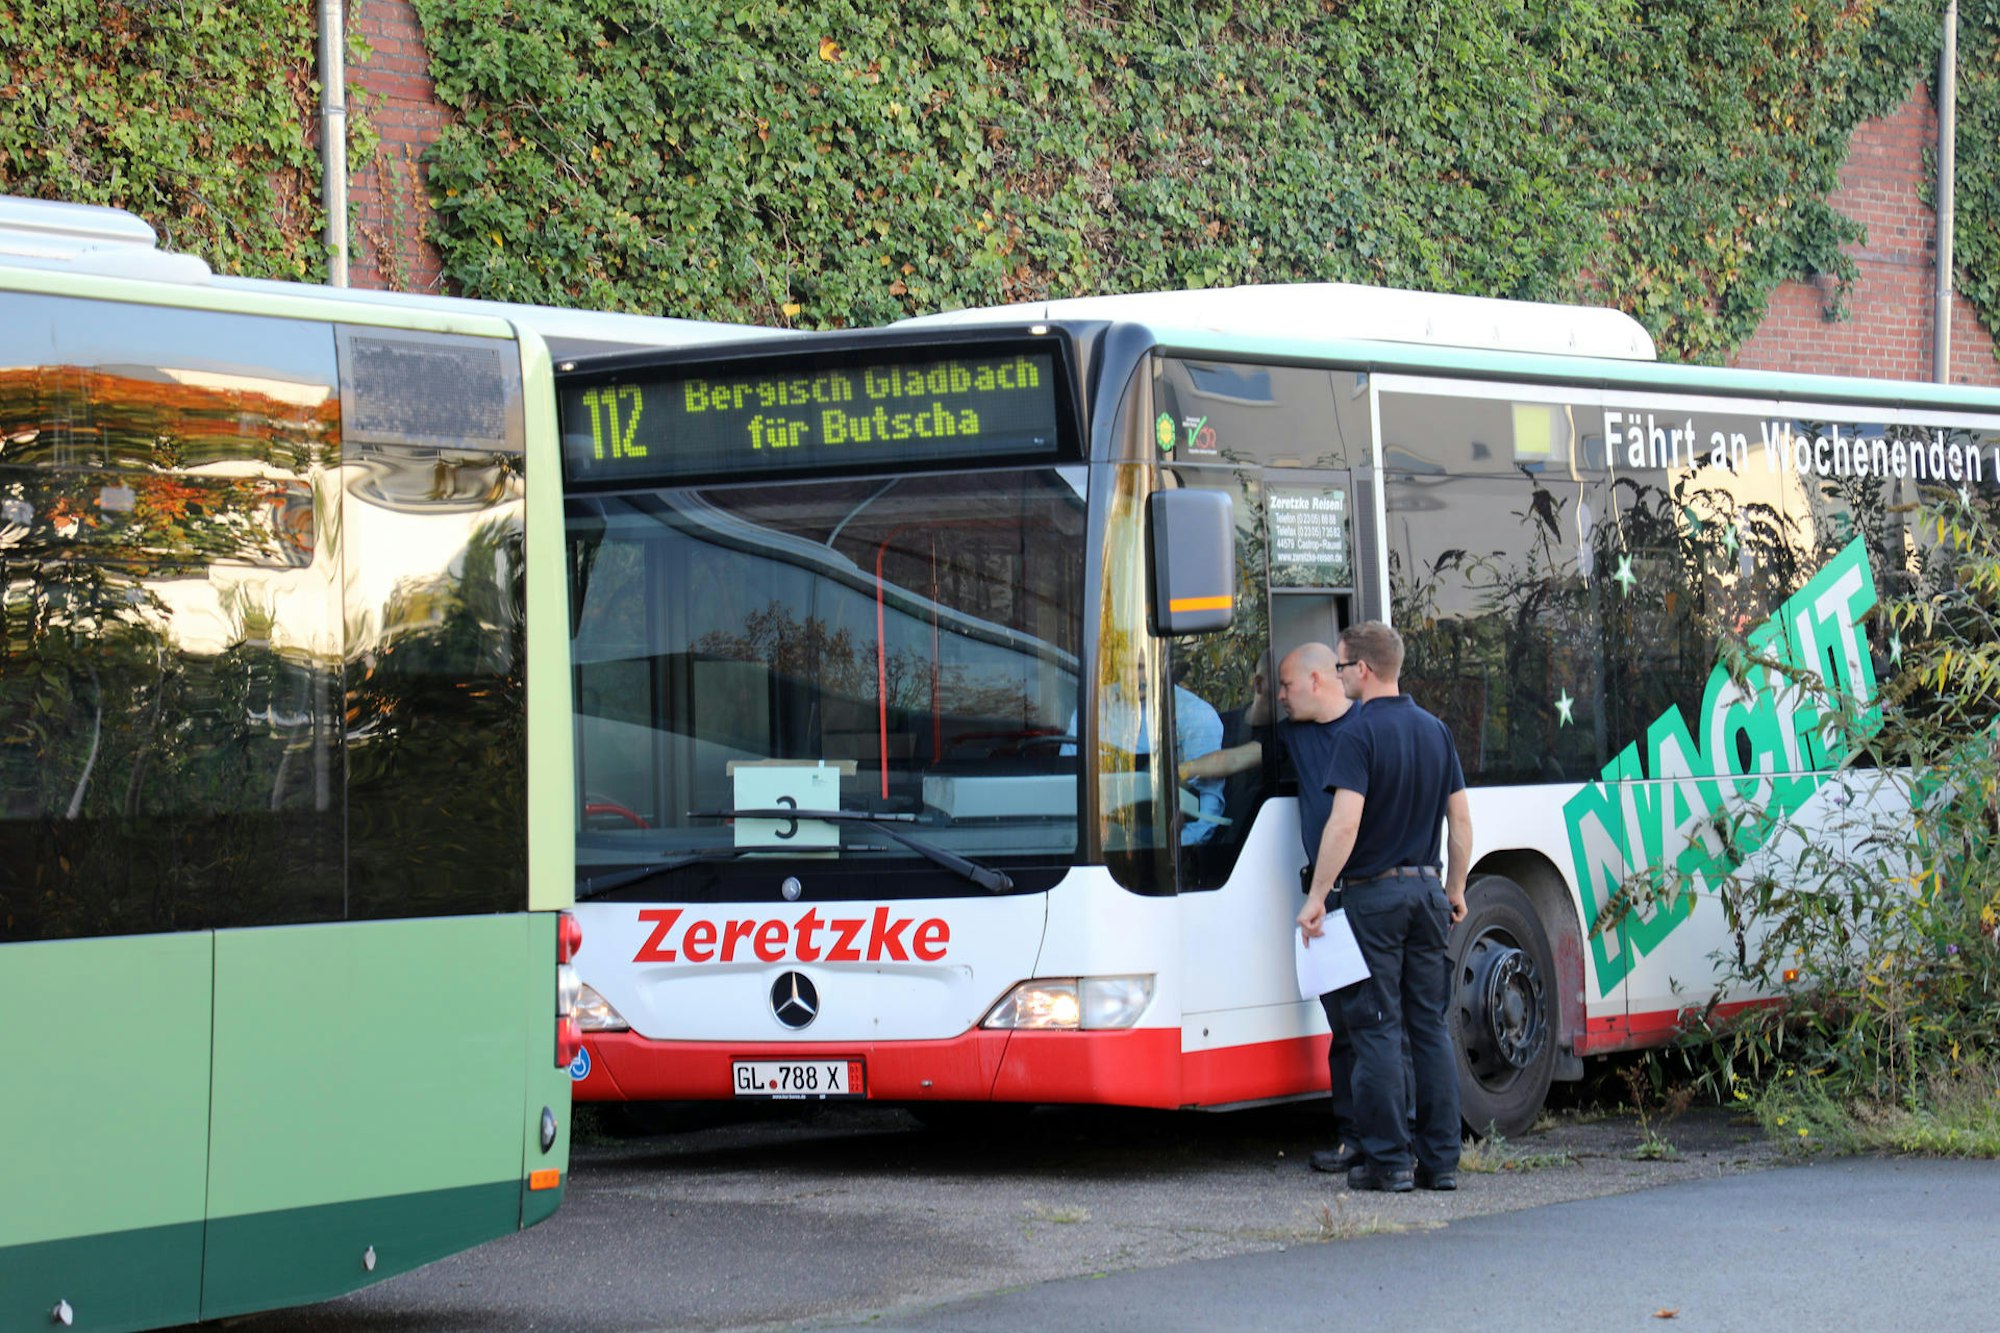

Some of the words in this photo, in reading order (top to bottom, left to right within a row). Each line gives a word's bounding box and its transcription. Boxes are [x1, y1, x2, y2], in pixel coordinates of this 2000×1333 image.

[684, 370, 852, 413] Bergisch
[865, 355, 1040, 399] Gladbach
[583, 384, 647, 459] 112
[747, 414, 808, 450] für
[821, 402, 980, 445] Butscha
[1604, 411, 1698, 471] Fährt
[1710, 430, 1749, 473] an
[1761, 420, 1983, 483] Wochenenden
[774, 795, 798, 839] 3
[632, 906, 951, 964] Zeretzke
[737, 1066, 765, 1090] GL
[779, 1066, 818, 1090] 788
[826, 1066, 840, 1090] X
